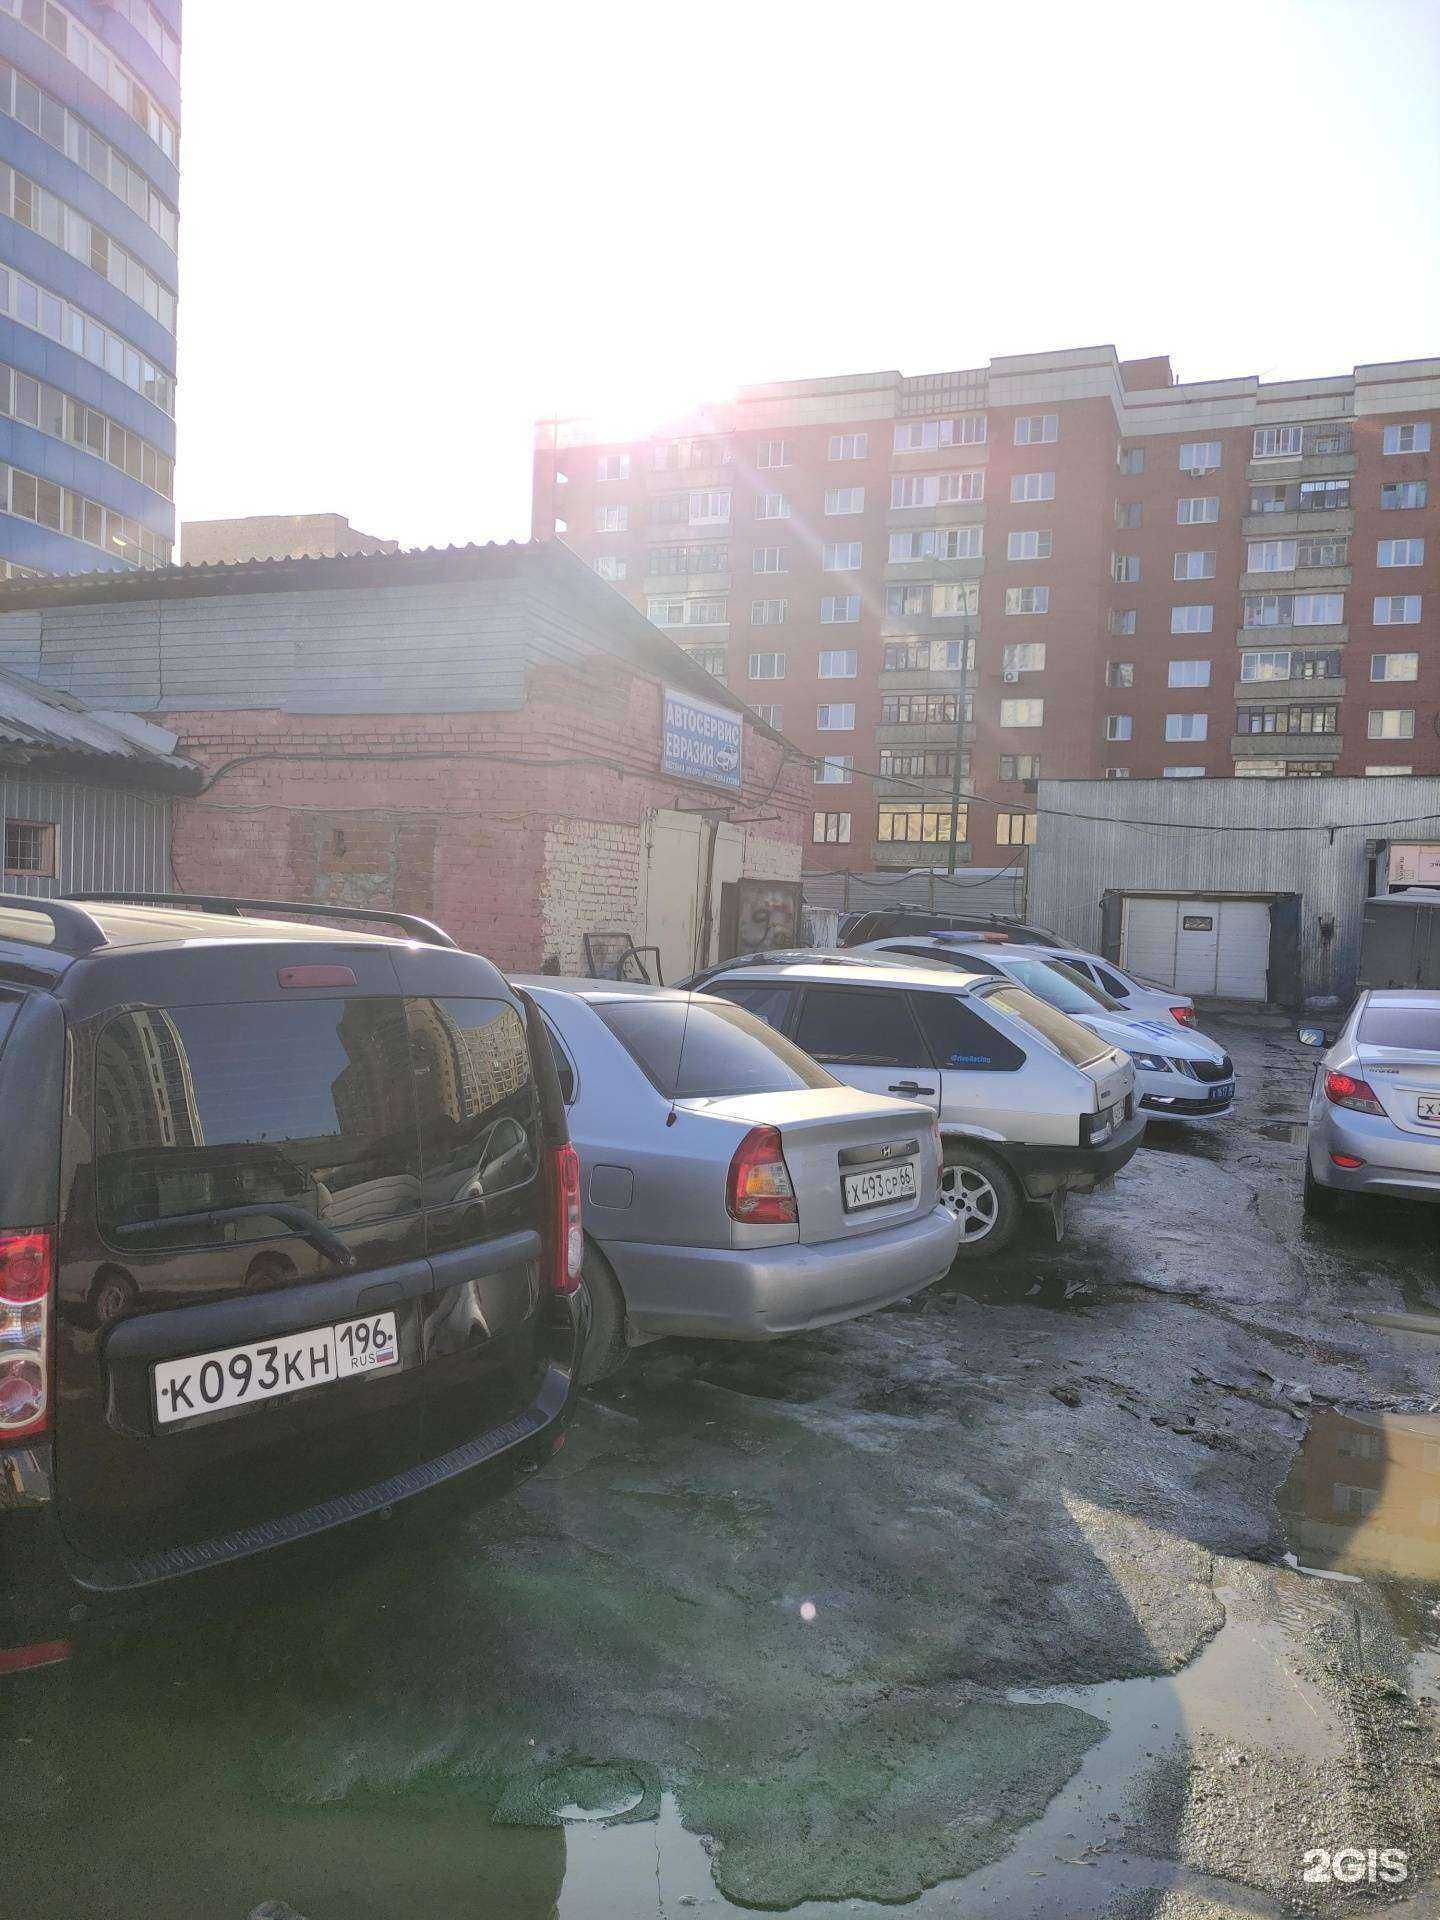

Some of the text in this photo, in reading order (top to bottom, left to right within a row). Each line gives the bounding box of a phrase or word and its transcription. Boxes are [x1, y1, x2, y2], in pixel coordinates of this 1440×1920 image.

[665, 702, 739, 746] АВТОСЕРВИС
[665, 732, 714, 767] ЕВРАЗИЯ
[851, 1174, 898, 1203] Х493СР
[169, 1318, 387, 1412] К093КН 196
[351, 1353, 376, 1369] RUS
